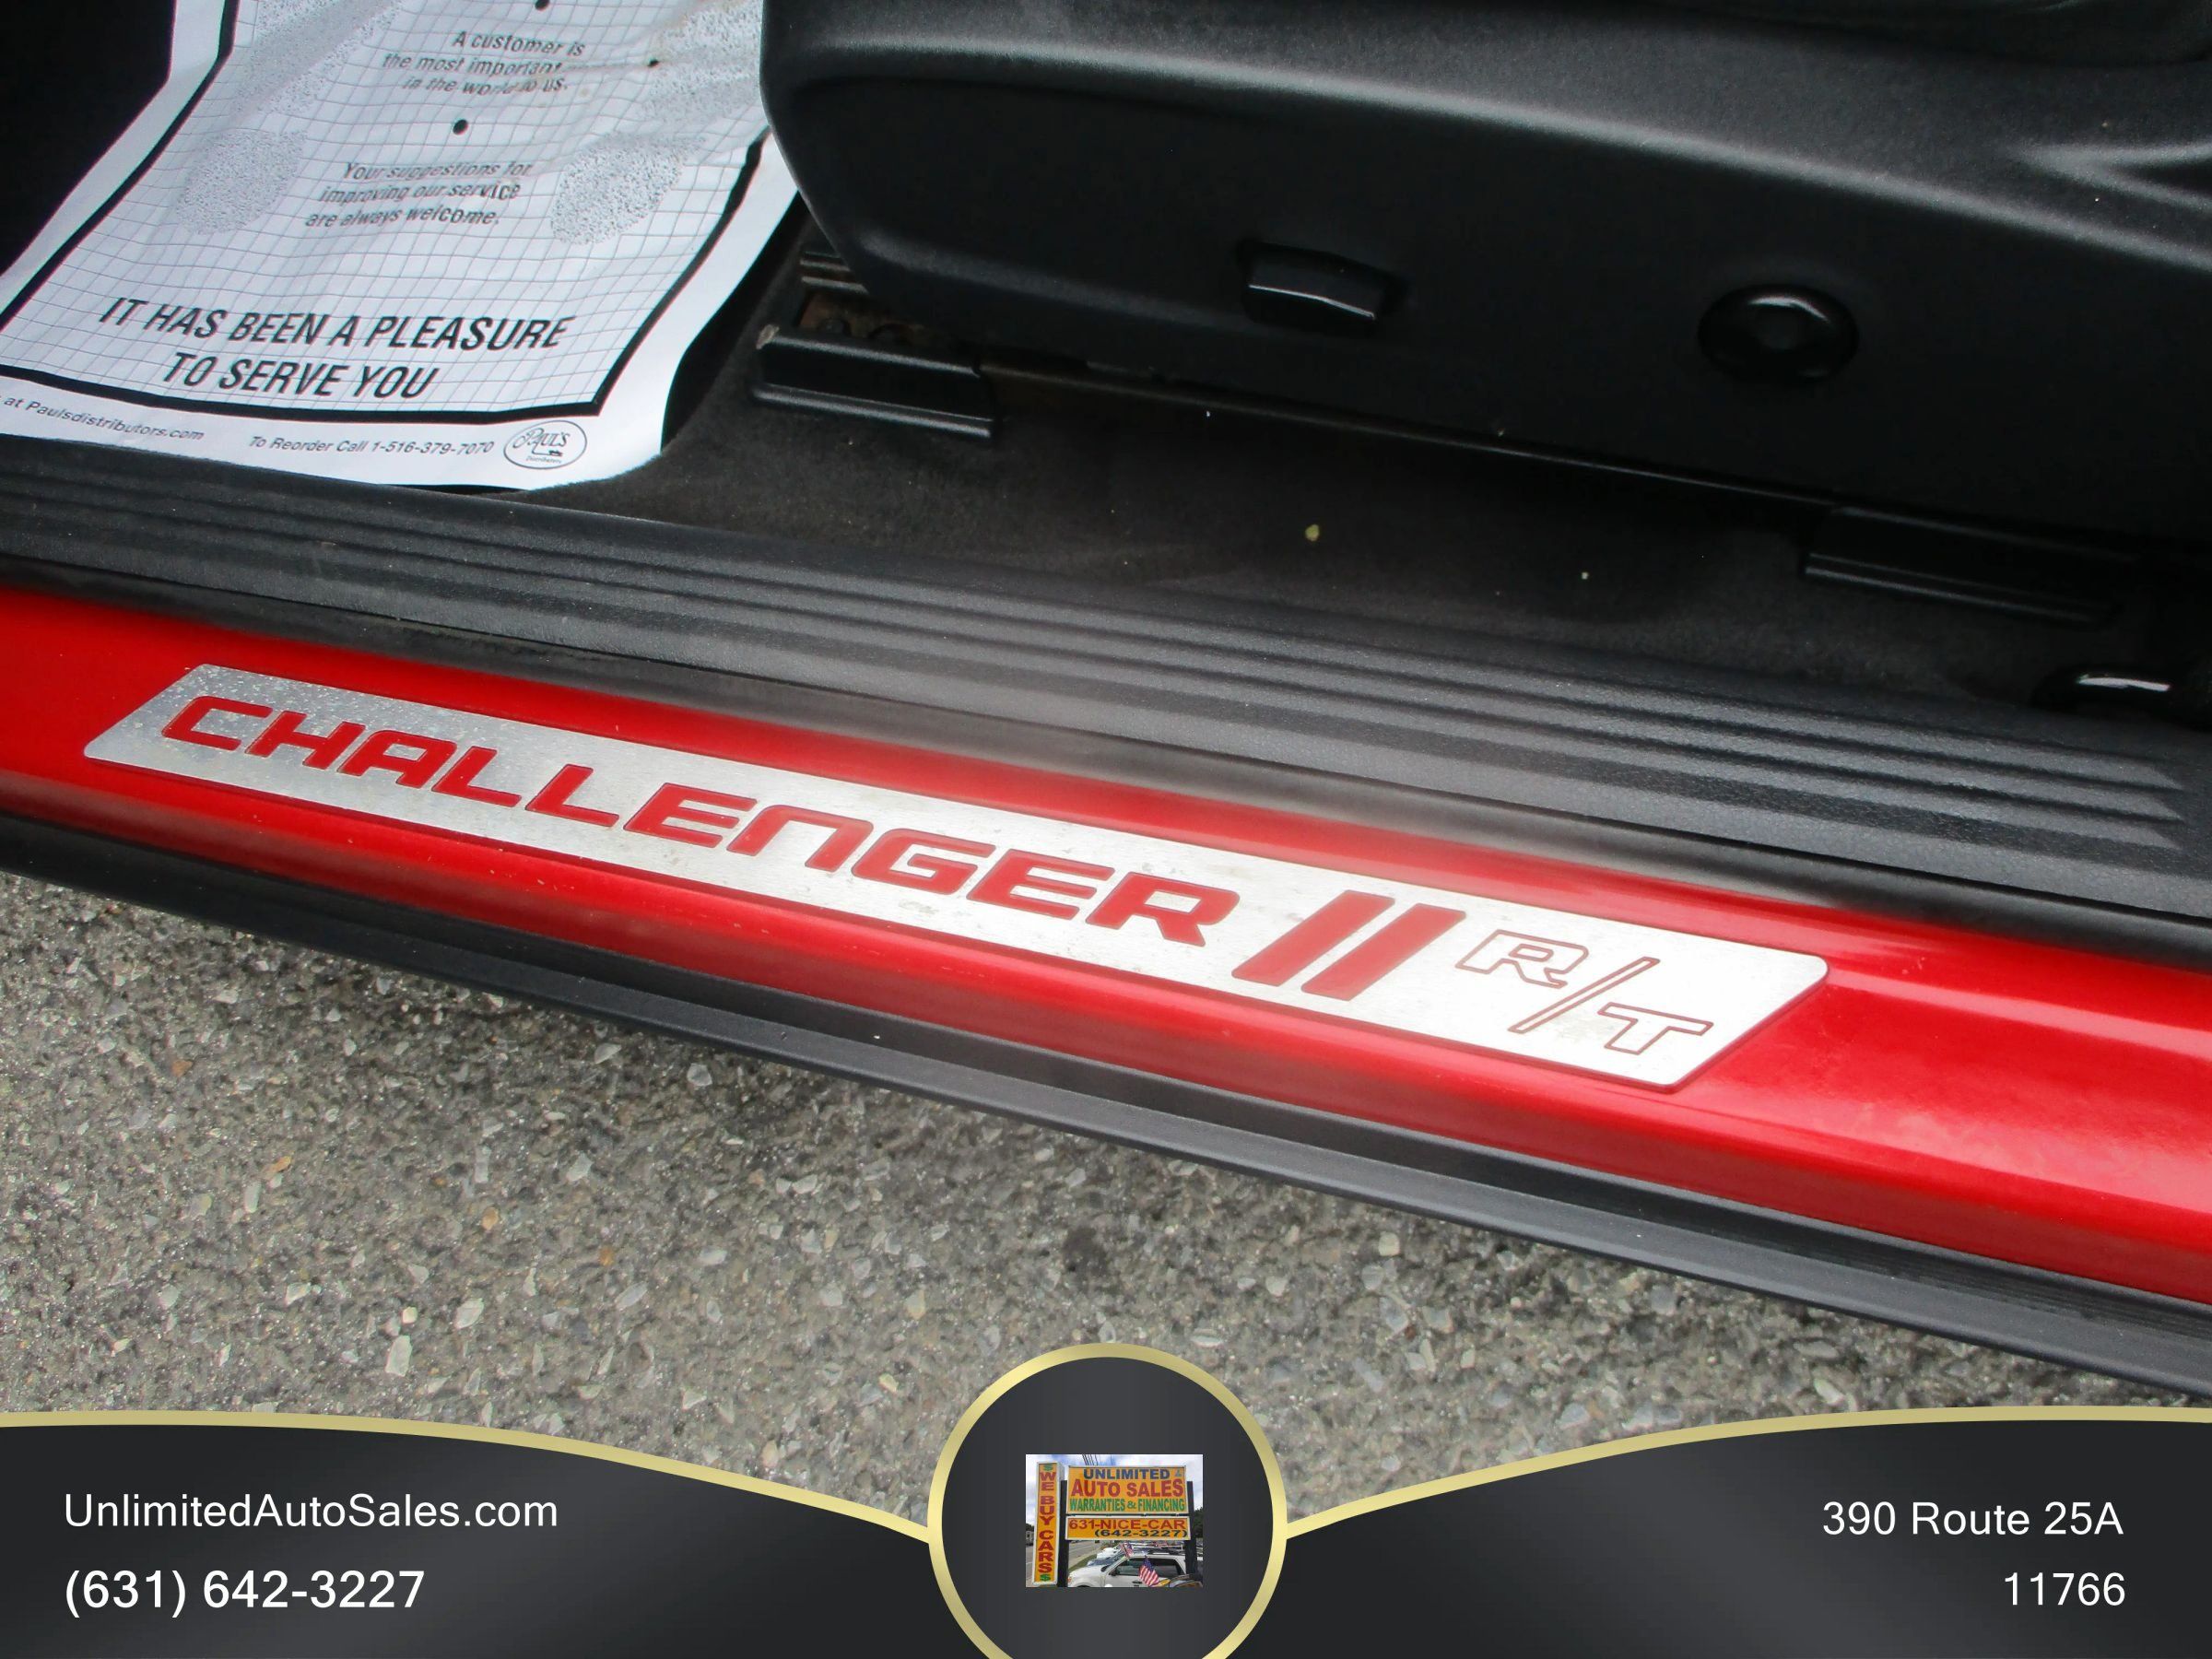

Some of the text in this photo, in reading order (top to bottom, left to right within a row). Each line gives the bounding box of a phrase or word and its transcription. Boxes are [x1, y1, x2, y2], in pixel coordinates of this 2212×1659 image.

[453, 30, 586, 57] A customer is
[383, 53, 562, 77] the most important
[403, 76, 421, 89] in
[426, 76, 457, 91] the
[343, 160, 534, 182] Your suggestions for
[319, 180, 522, 207] improving our service
[305, 204, 500, 228] are always welcome.
[99, 297, 576, 351] IT HAS BEEN A PLEASURE
[163, 352, 440, 399] TO SERVE YOU
[4, 395, 206, 441] at Paulsdistributors.com
[249, 436, 495, 455] To Reorder Call 1-516-379-7070
[160, 694, 1714, 1055] CHALLENGER R/T
